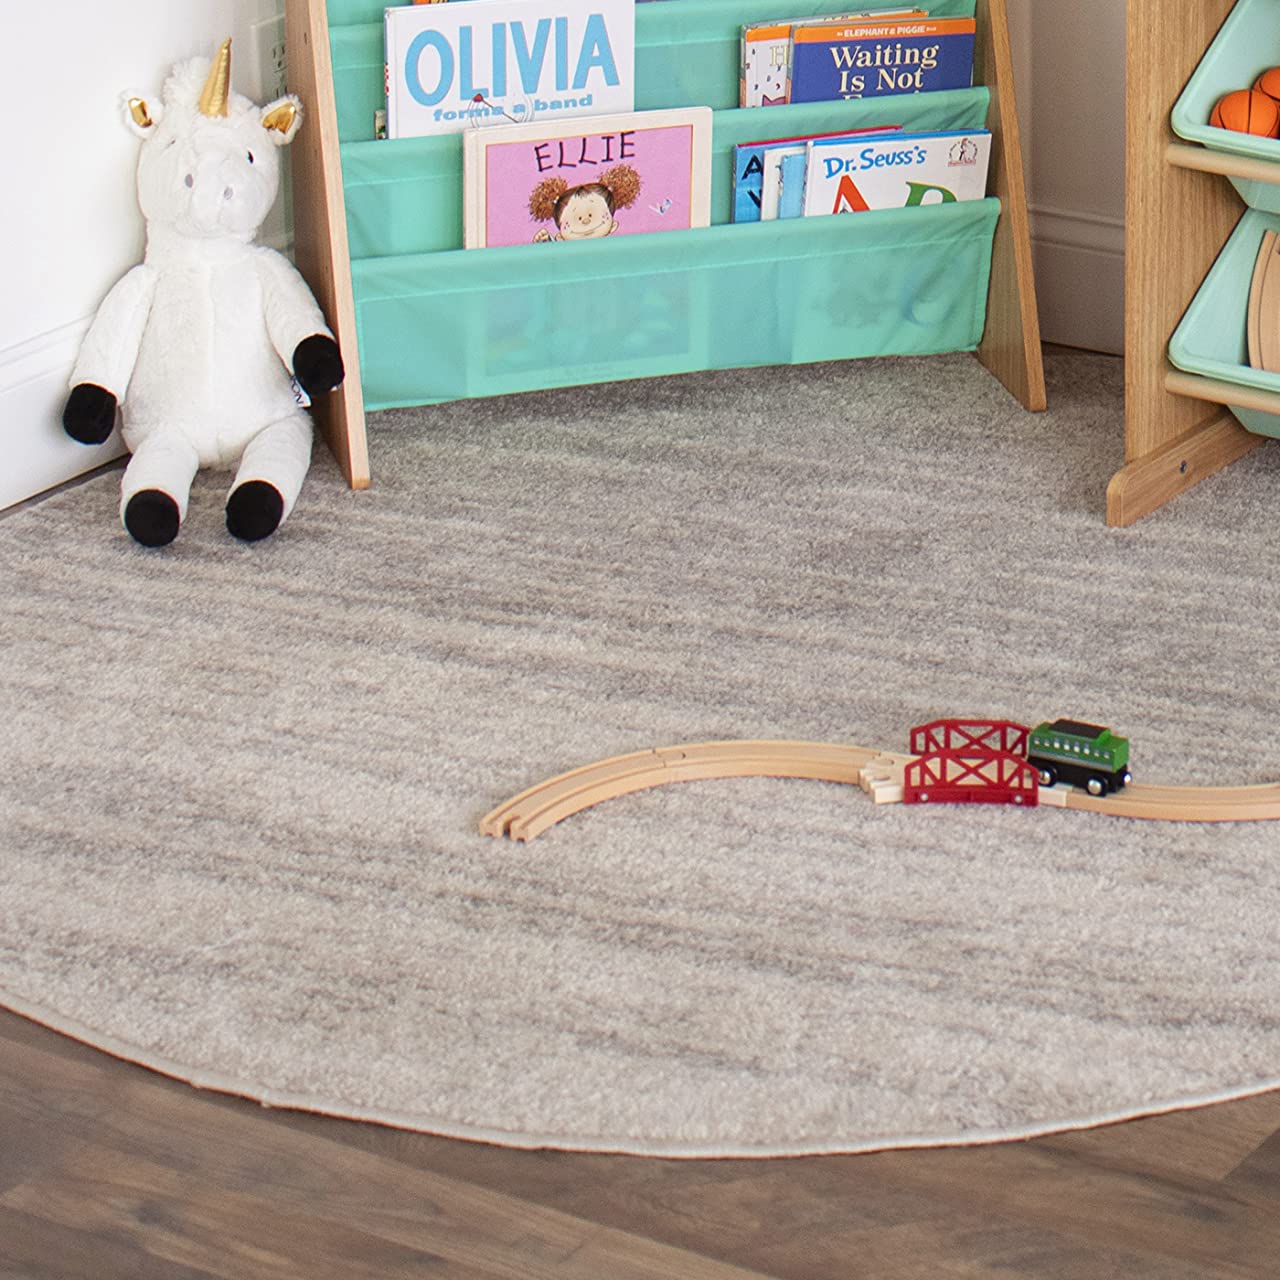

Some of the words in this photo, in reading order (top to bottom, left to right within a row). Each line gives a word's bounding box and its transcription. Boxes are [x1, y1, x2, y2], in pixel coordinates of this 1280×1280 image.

[844, 27, 889, 38] ELEPHANT
[897, 25, 925, 34] PIGGIE
[405, 13, 620, 107] OLIVIA
[830, 43, 940, 69] Waiting
[838, 70, 865, 93] Is
[876, 66, 924, 91] Not
[433, 106, 504, 122] forms
[513, 103, 526, 114] a
[534, 94, 593, 111] band
[534, 130, 637, 172] ELLIE
[823, 157, 857, 179] Dr.
[859, 145, 927, 171] Seuss's
